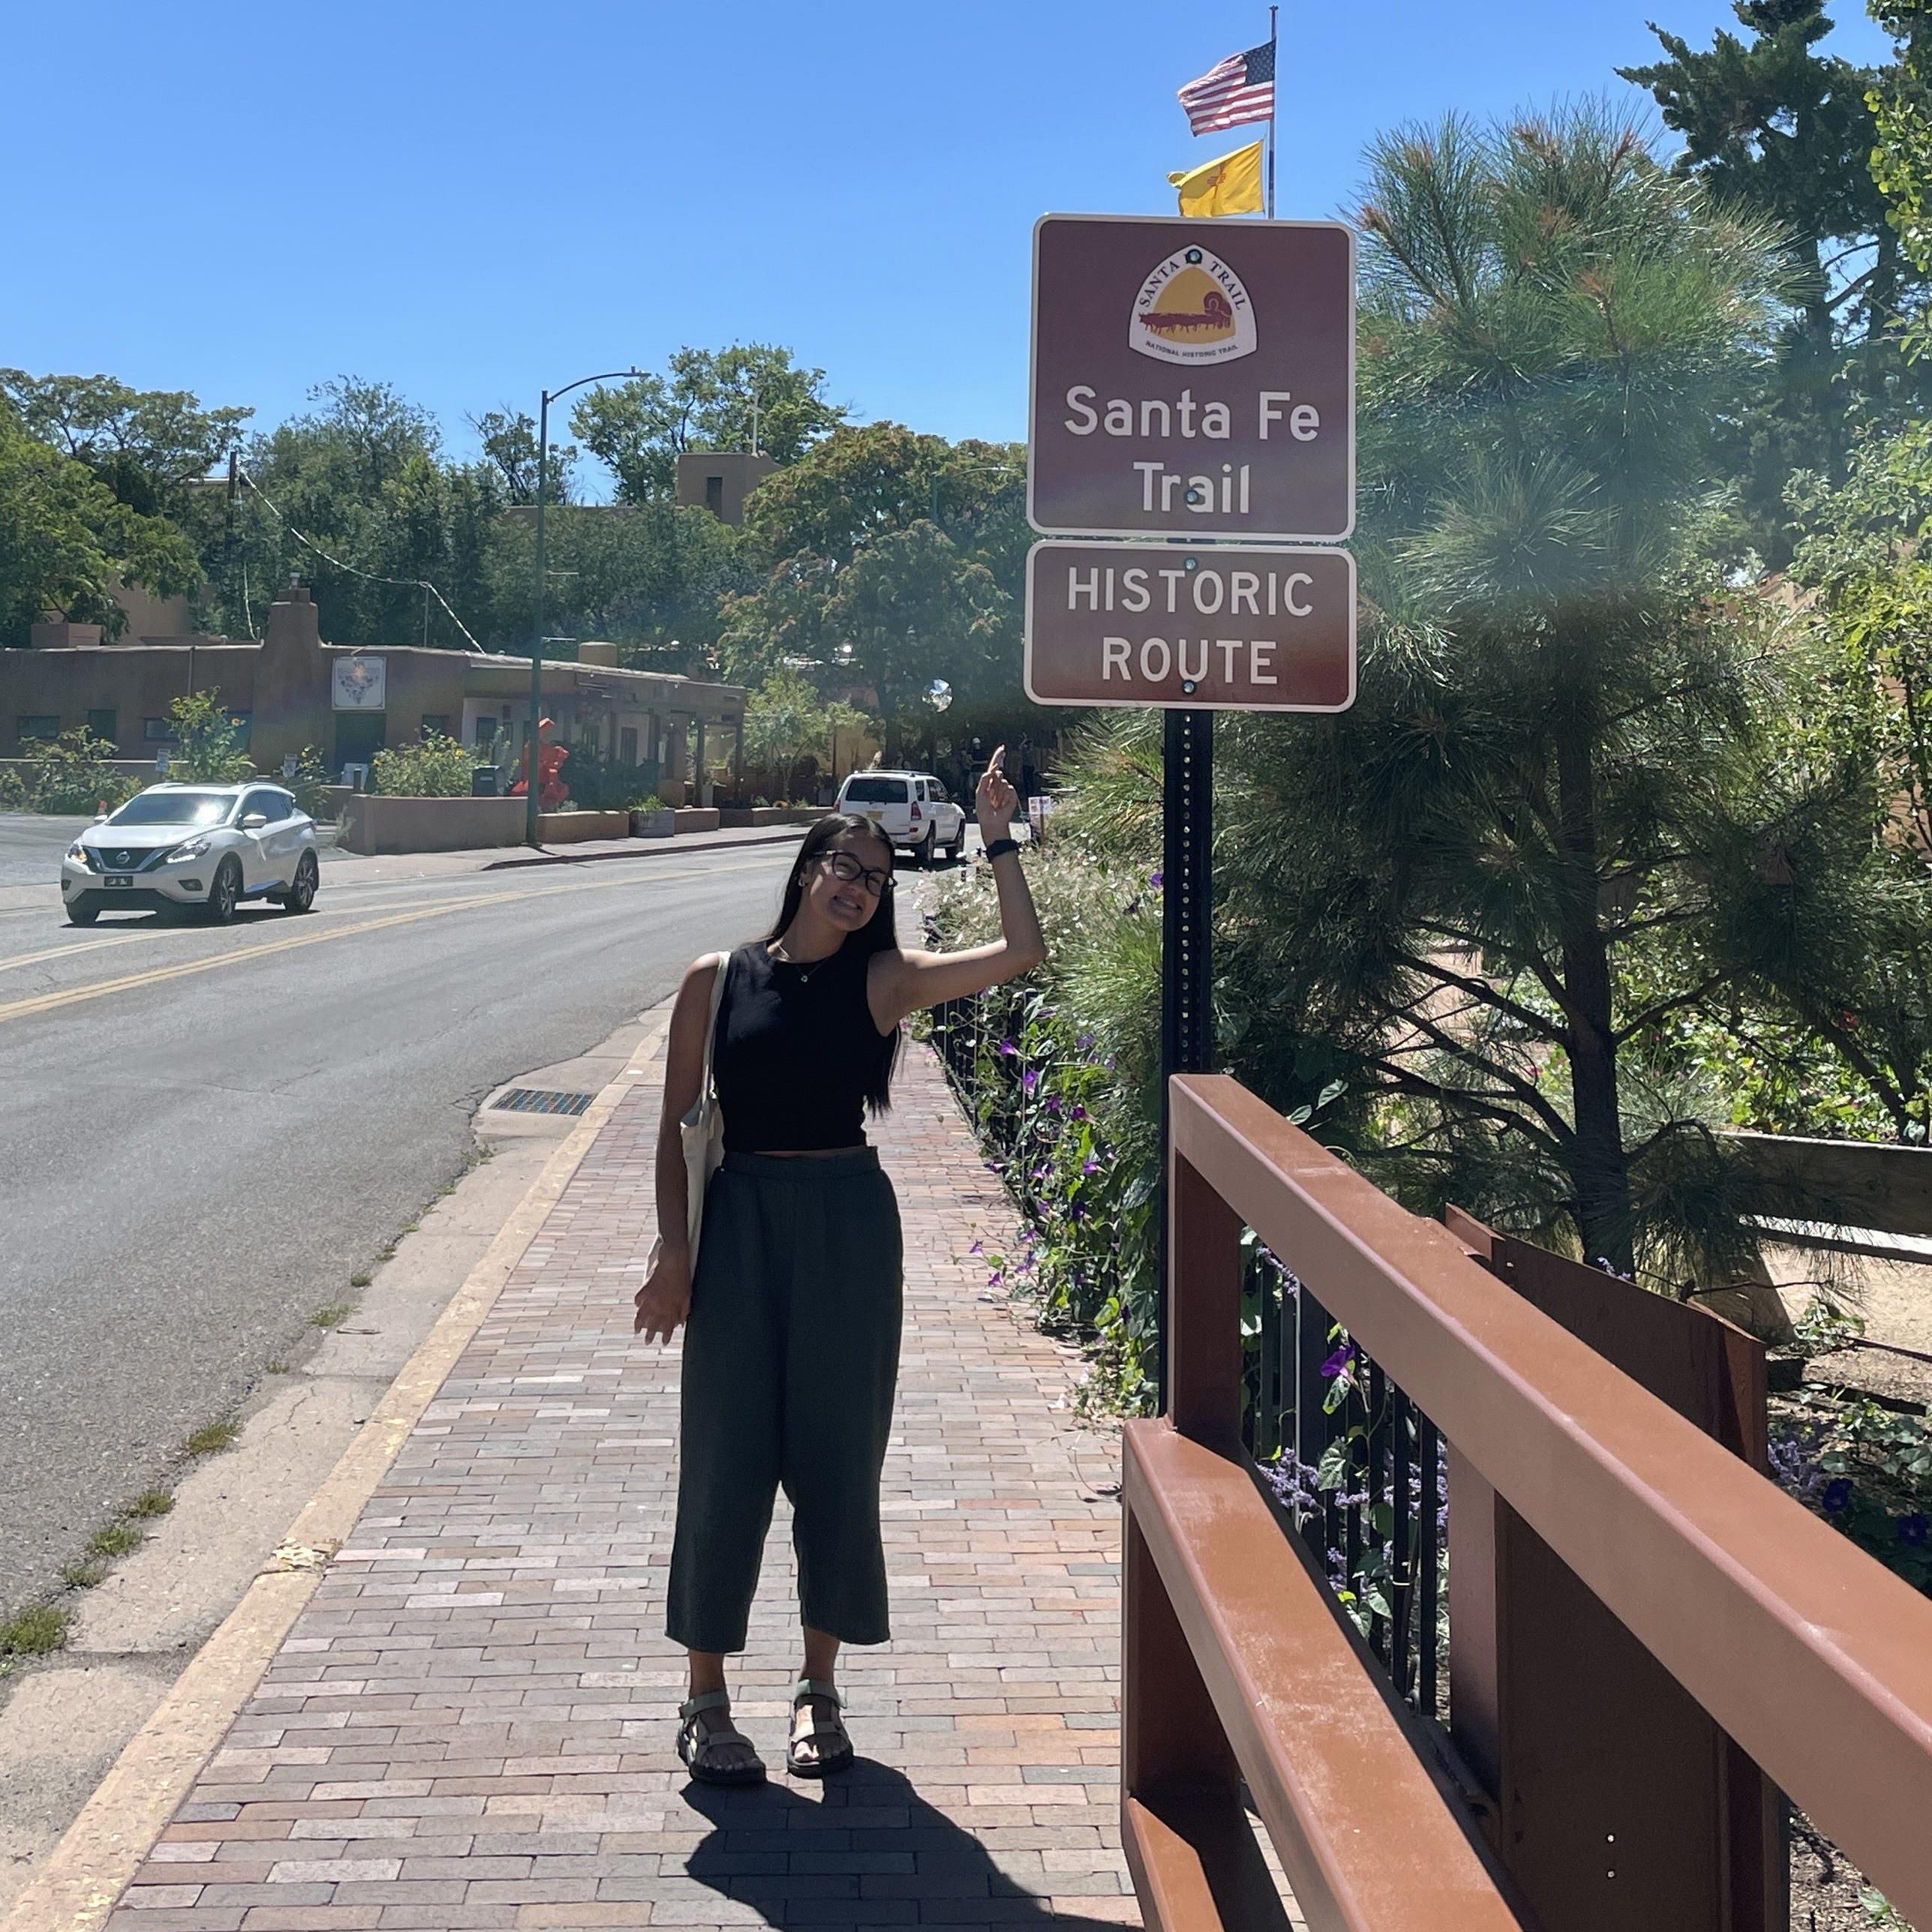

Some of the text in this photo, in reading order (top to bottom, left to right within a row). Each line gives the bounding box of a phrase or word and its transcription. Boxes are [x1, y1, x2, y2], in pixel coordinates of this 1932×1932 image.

[1139, 260, 1246, 310] SANTA TRAIL
[1145, 340, 1238, 358] NATIONAL HISTORIC TRAIL
[1064, 386, 1320, 441] Santa Fe
[1133, 461, 1250, 514] Trail
[1068, 567, 1314, 616] HISTORIC
[1102, 637, 1278, 684] ROUTE
